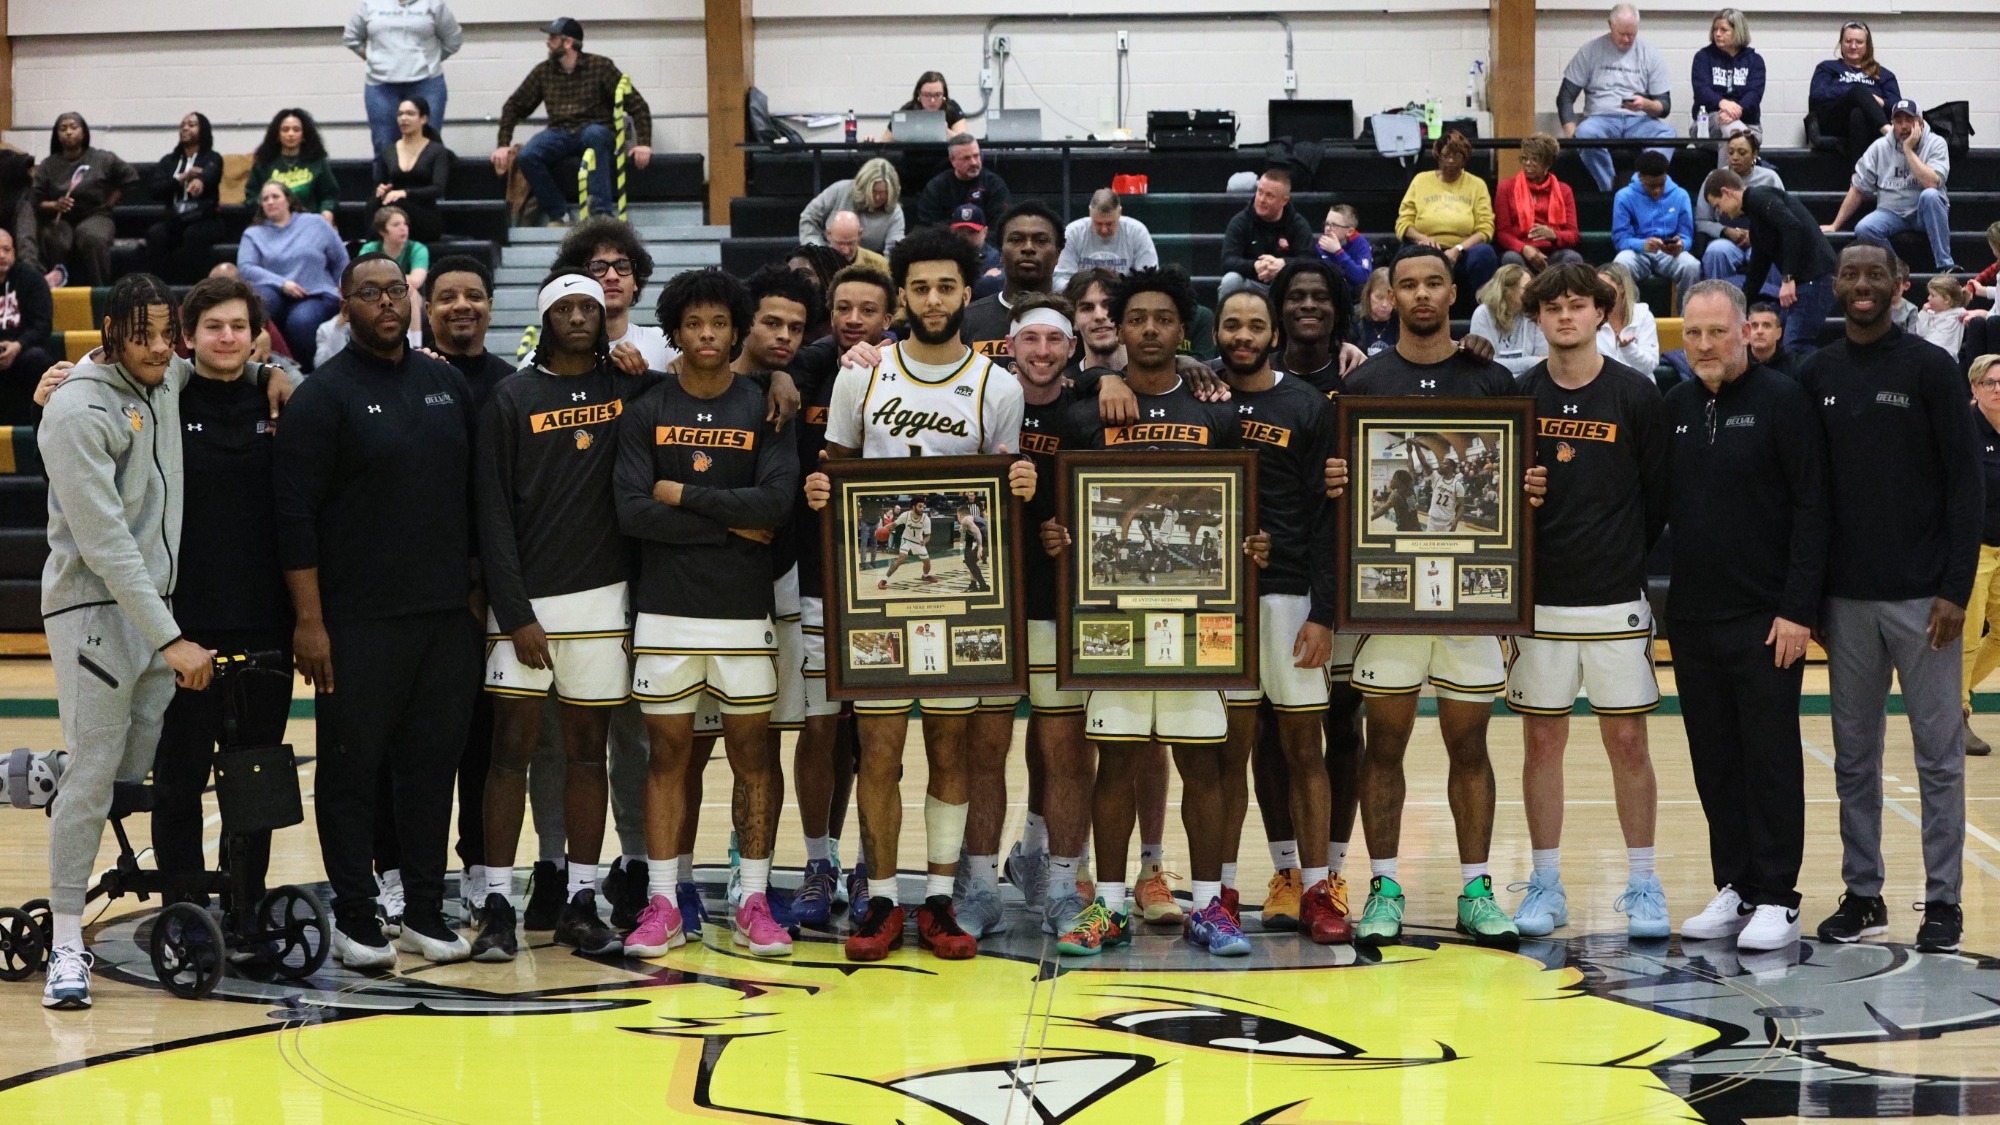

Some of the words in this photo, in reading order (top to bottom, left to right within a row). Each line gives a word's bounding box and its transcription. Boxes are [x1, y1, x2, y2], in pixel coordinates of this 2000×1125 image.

[956, 388, 972, 397] MAC
[541, 402, 616, 429] AGGIES
[872, 396, 968, 438] Aggies
[663, 427, 748, 447] AGGIES
[1113, 425, 1202, 442] AGGIES
[1021, 434, 1058, 454] GIE
[1436, 493, 1449, 507] 22
